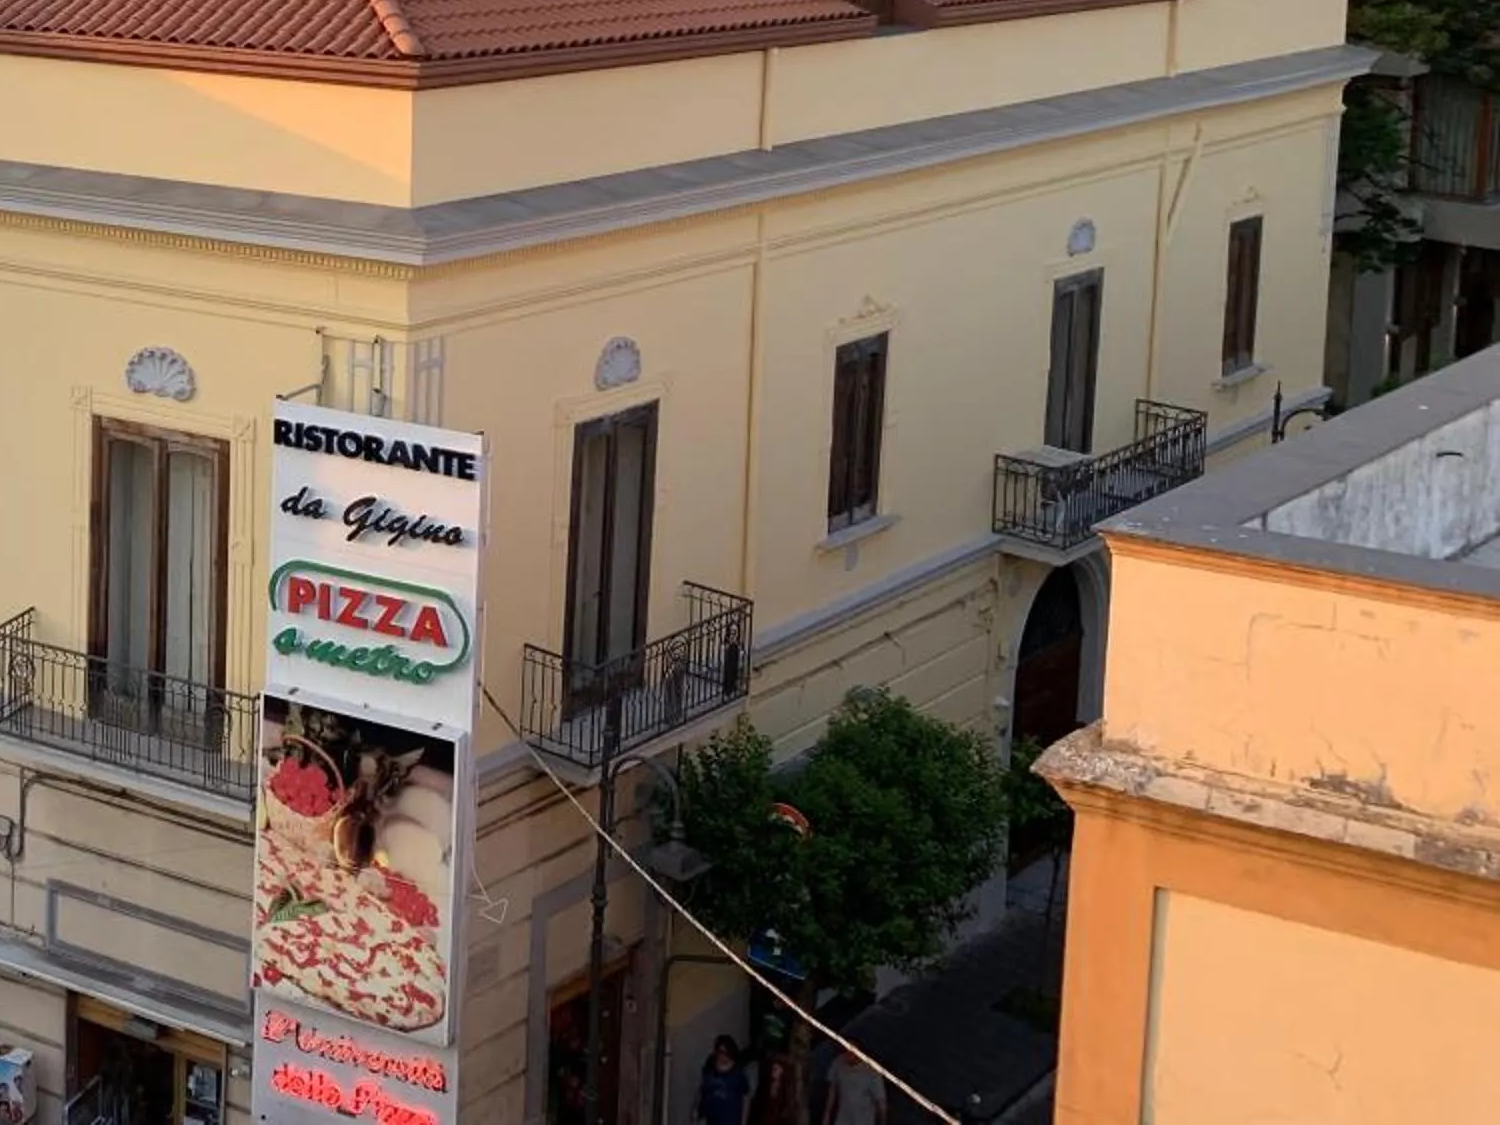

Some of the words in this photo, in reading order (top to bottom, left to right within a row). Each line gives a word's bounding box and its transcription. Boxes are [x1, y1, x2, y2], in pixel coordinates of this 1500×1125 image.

[273, 418, 478, 481] RISTORANTE
[281, 486, 325, 520] da
[343, 496, 465, 547] Gigino
[286, 576, 449, 648] PIZZA
[304, 636, 438, 686] metro
